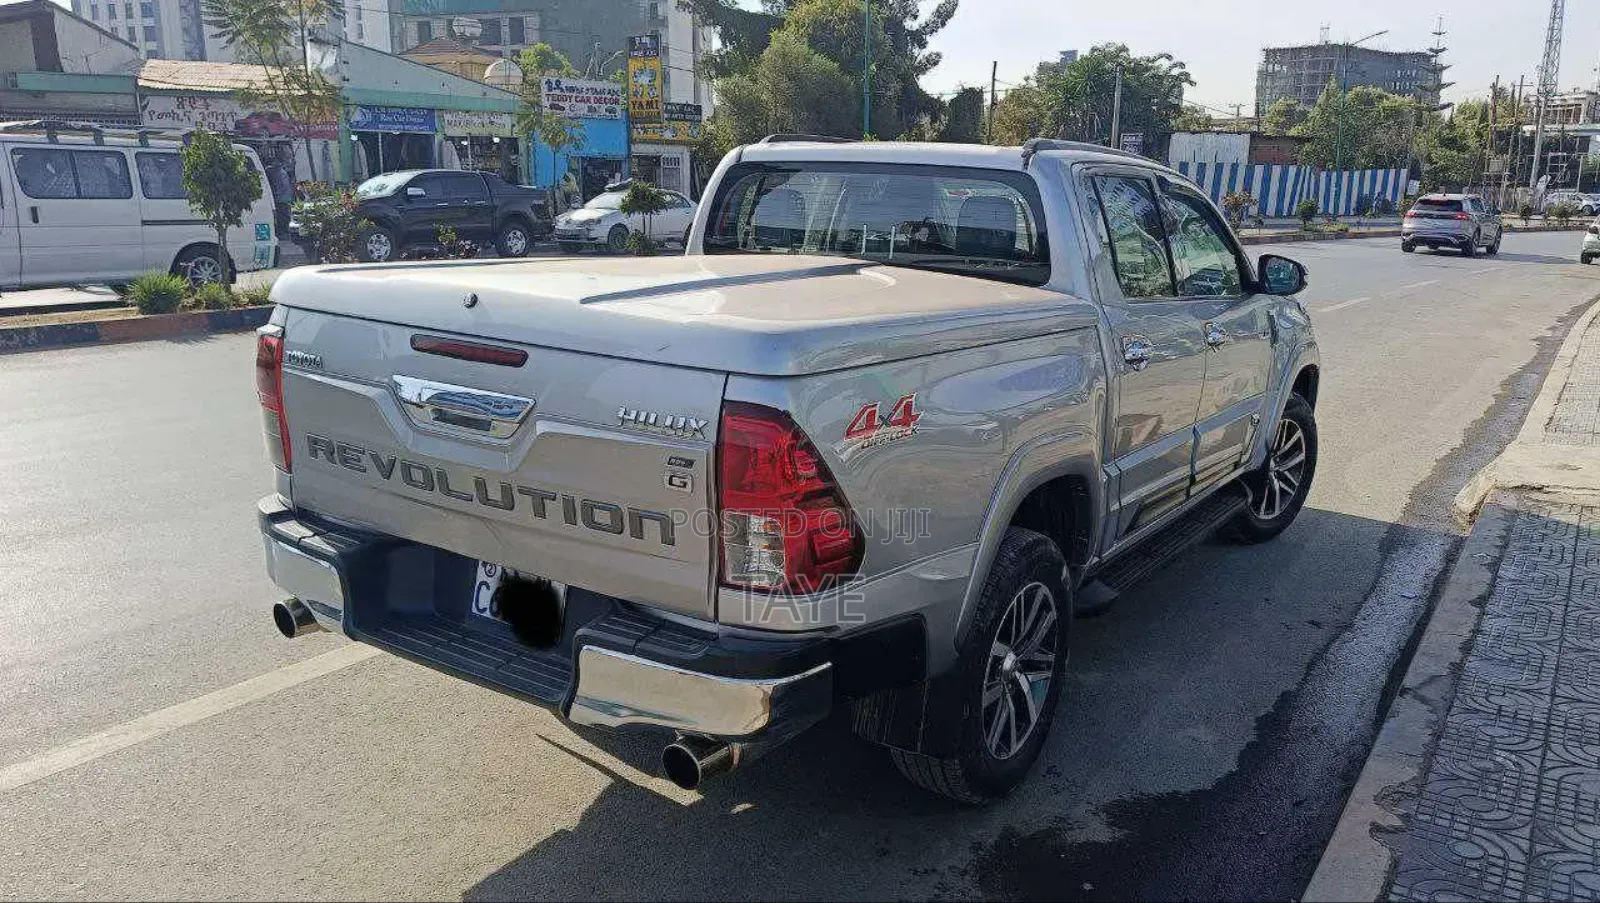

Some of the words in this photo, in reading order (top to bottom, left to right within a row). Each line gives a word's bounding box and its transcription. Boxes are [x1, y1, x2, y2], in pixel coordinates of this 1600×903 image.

[545, 93, 573, 103] TEDDY
[574, 94, 592, 104] CAR
[593, 95, 620, 105] DECOR
[285, 350, 324, 370] TOYOTA
[617, 405, 709, 440] HILUX
[844, 392, 923, 441] 4x4
[306, 433, 675, 546] REVOLUTION
[668, 474, 687, 489] G
